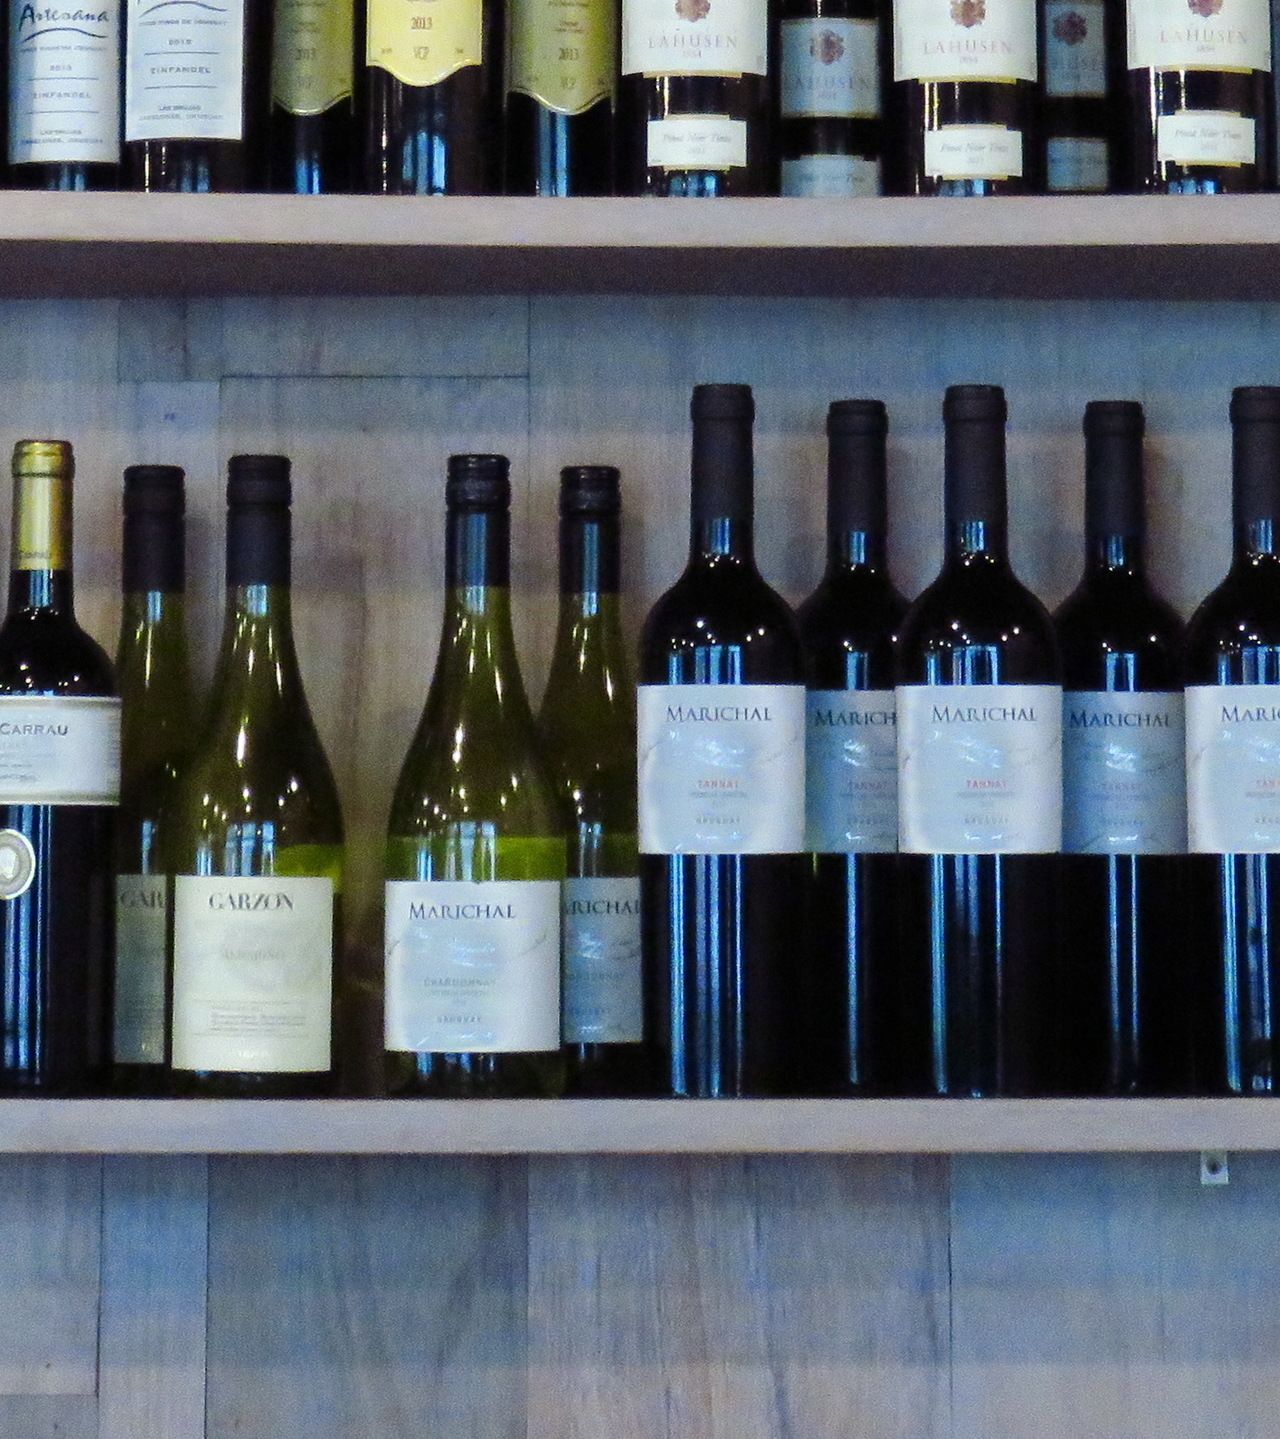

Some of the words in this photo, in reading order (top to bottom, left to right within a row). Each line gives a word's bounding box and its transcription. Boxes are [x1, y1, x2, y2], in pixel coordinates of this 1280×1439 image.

[18, 4, 110, 32] Artesana
[410, 17, 433, 30] 2013
[648, 34, 738, 50] LAHUSEN
[1159, 29, 1248, 44] LAHUSEN
[923, 39, 1013, 54] LAHUSEN
[150, 66, 212, 75] ZINFANDEL
[666, 705, 772, 723] MARICHAL
[815, 709, 896, 727] MARICH
[931, 705, 1038, 724] MARICHAL
[0, 722, 70, 736] CARRAU
[697, 779, 739, 789] TANNAT
[966, 778, 1007, 789] TANNAT
[409, 902, 517, 921] MARICHAL
